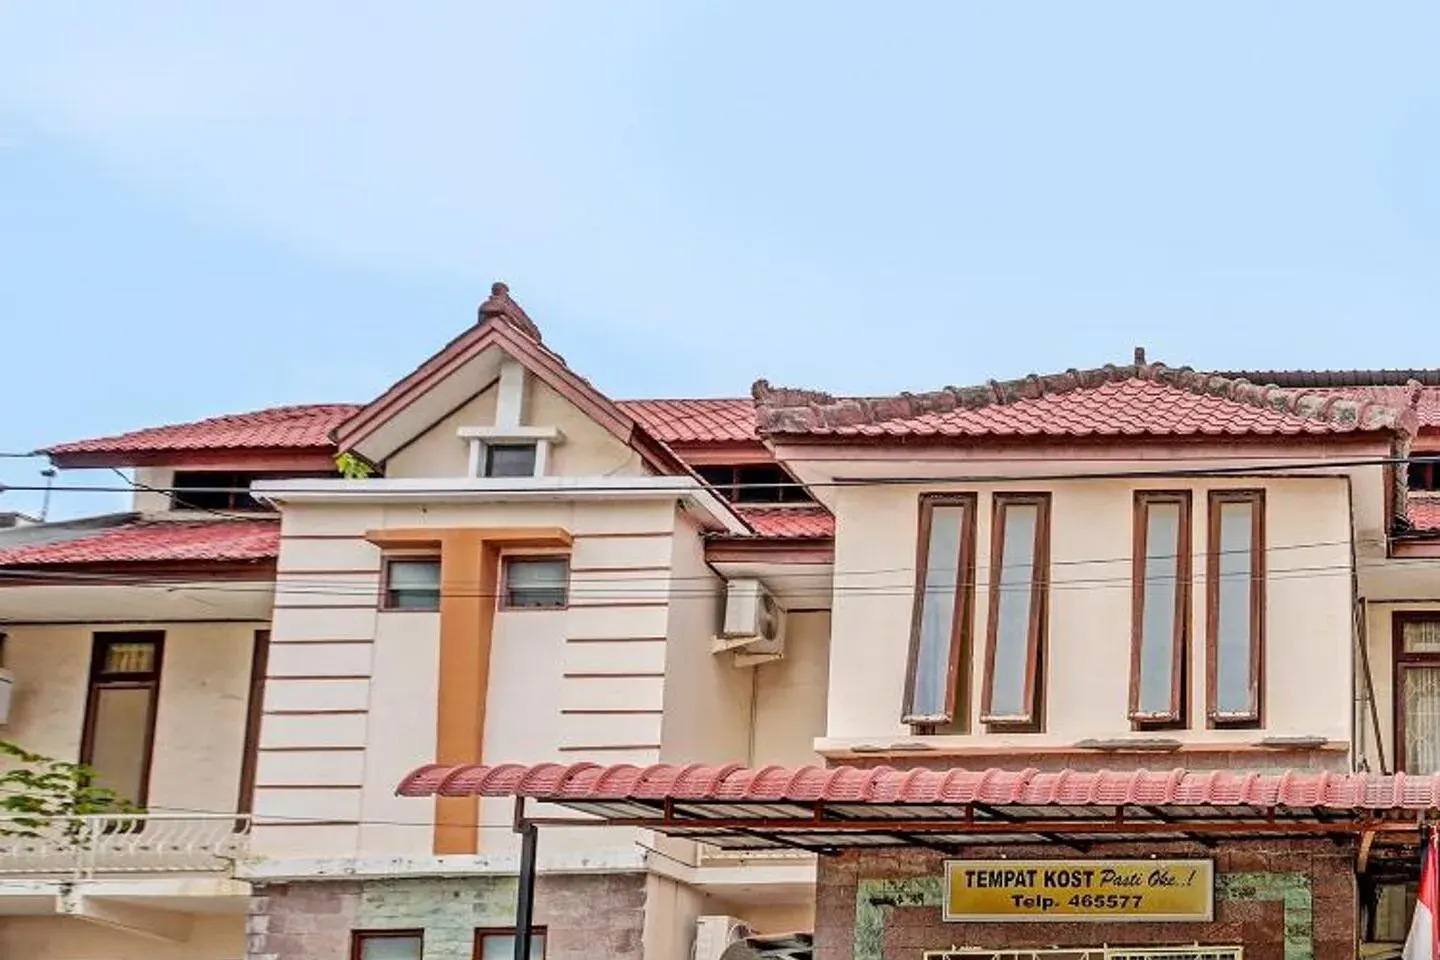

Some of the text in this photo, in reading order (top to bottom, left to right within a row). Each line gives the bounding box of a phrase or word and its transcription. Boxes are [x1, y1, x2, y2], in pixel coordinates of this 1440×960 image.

[965, 870, 1038, 888] TEMPAT
[1044, 870, 1094, 888] KOST
[1099, 869, 1143, 886] Pasti
[1011, 894, 1143, 911] Telp. 465577
